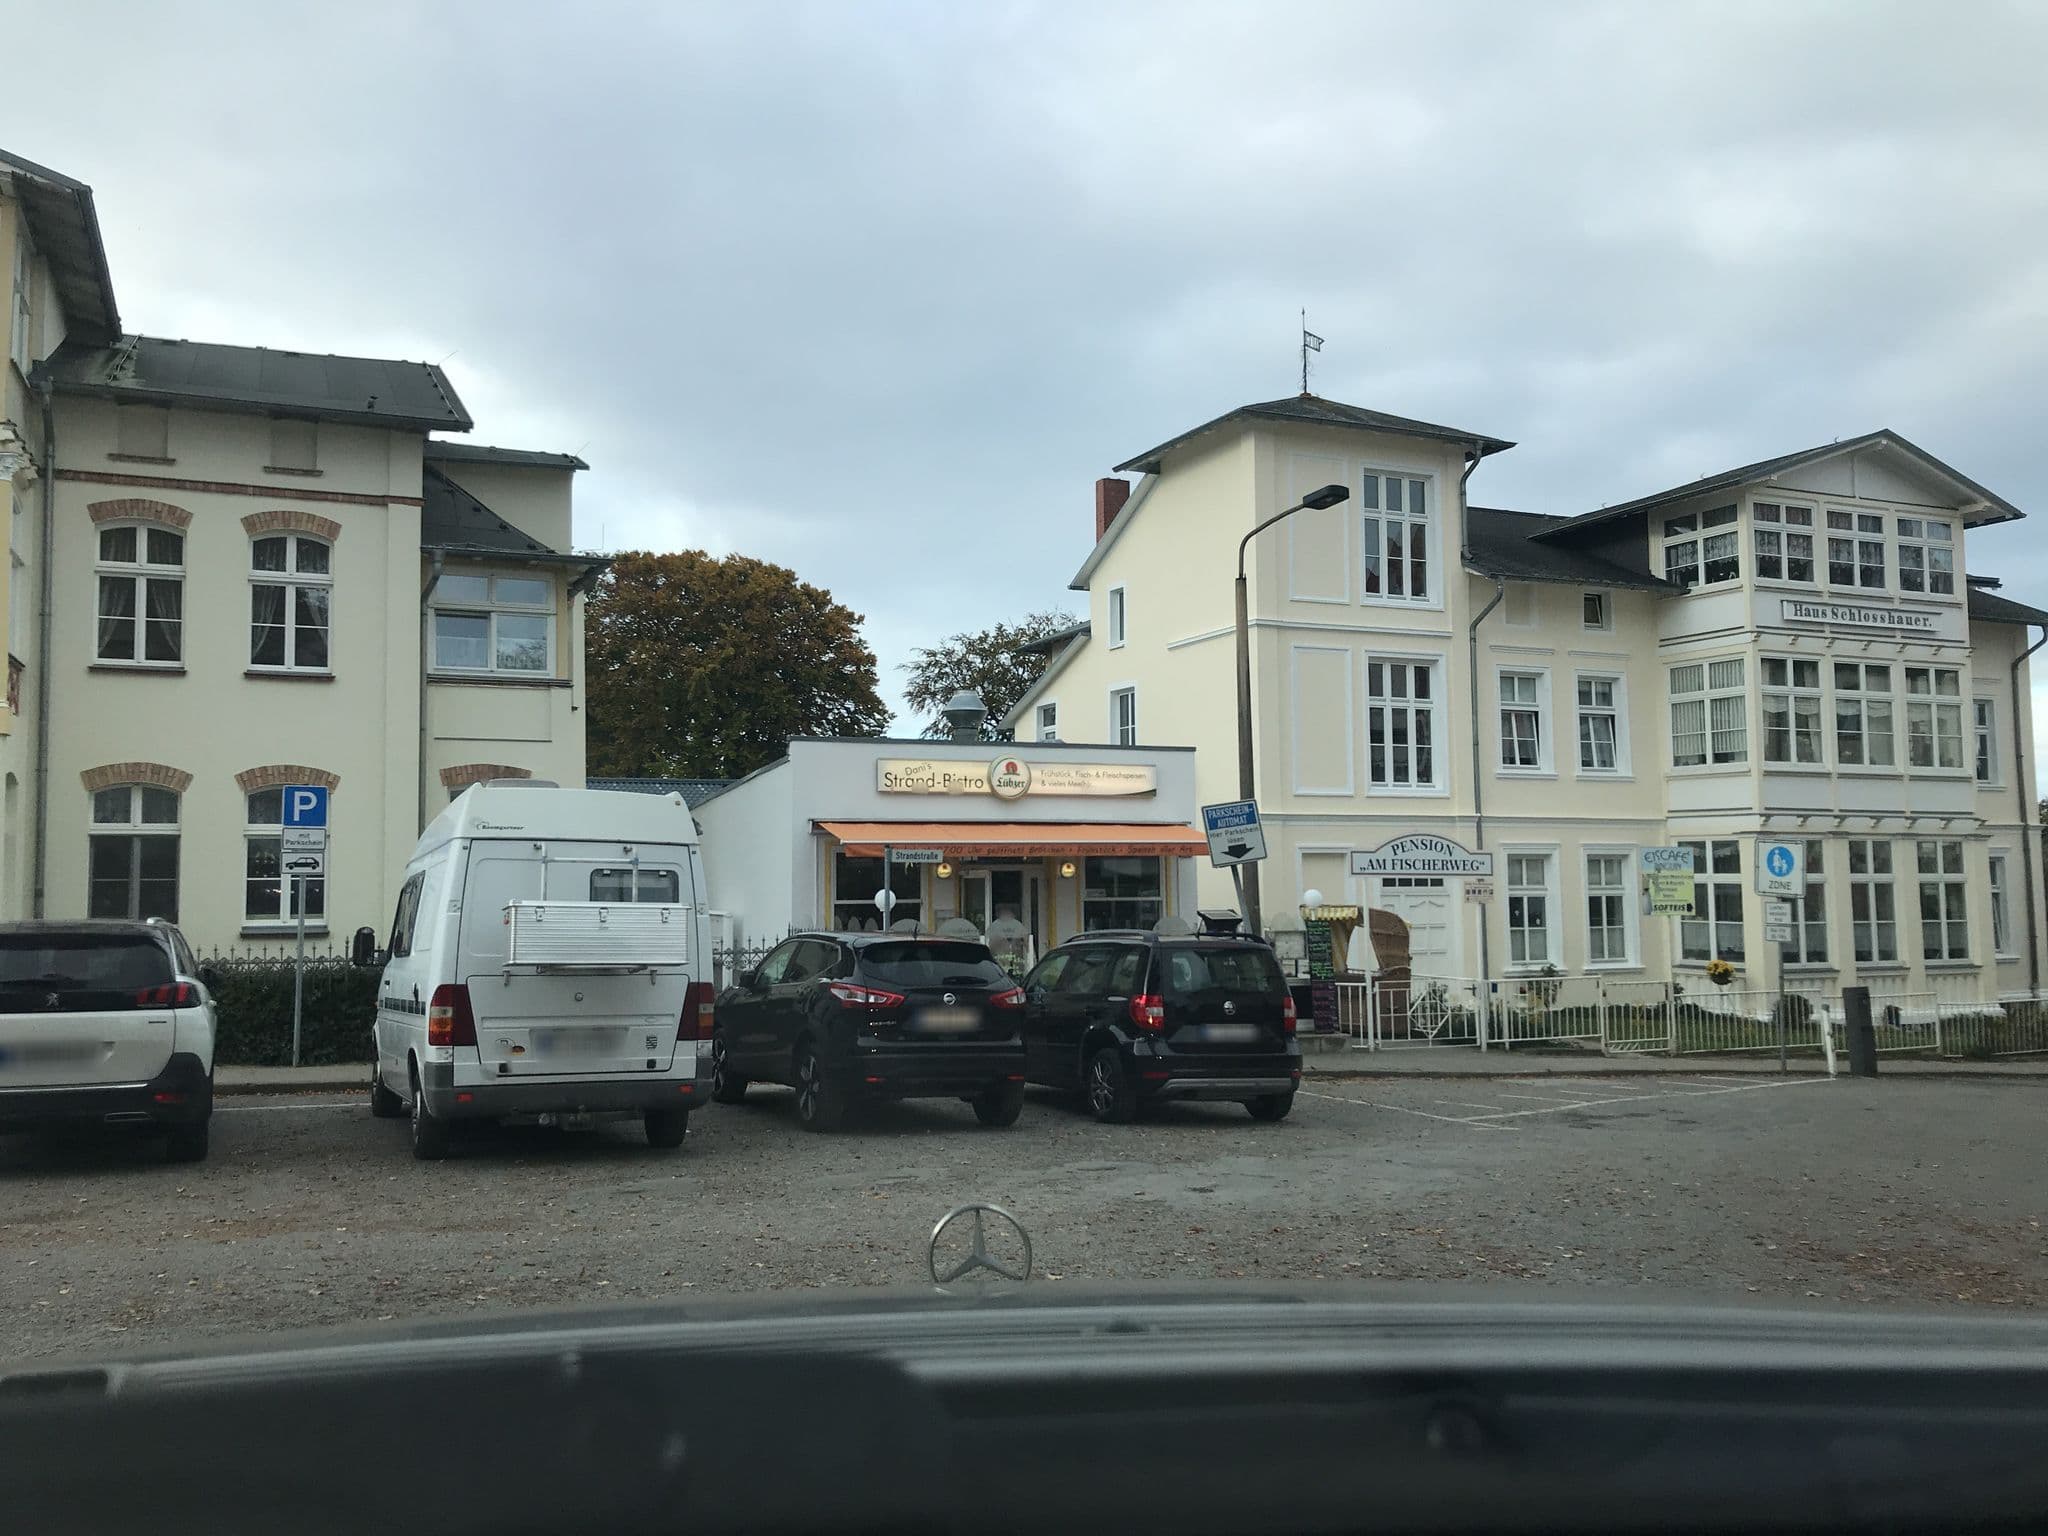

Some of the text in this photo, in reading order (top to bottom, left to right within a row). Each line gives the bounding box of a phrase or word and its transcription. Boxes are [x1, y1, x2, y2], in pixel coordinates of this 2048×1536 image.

[1793, 603, 1933, 627] Haus Schlosshauer.
[904, 763, 932, 776] Dani's
[996, 778, 1026, 789] Lübzer
[293, 791, 318, 821] P
[1207, 805, 1253, 818] PARKSCHEIN-
[1217, 815, 1247, 828] AUTOMAT
[1225, 826, 1259, 836] Parkschein
[1391, 839, 1455, 857] PENSION
[895, 851, 939, 860] Strandstraße
[1768, 880, 1792, 890] ZONE
